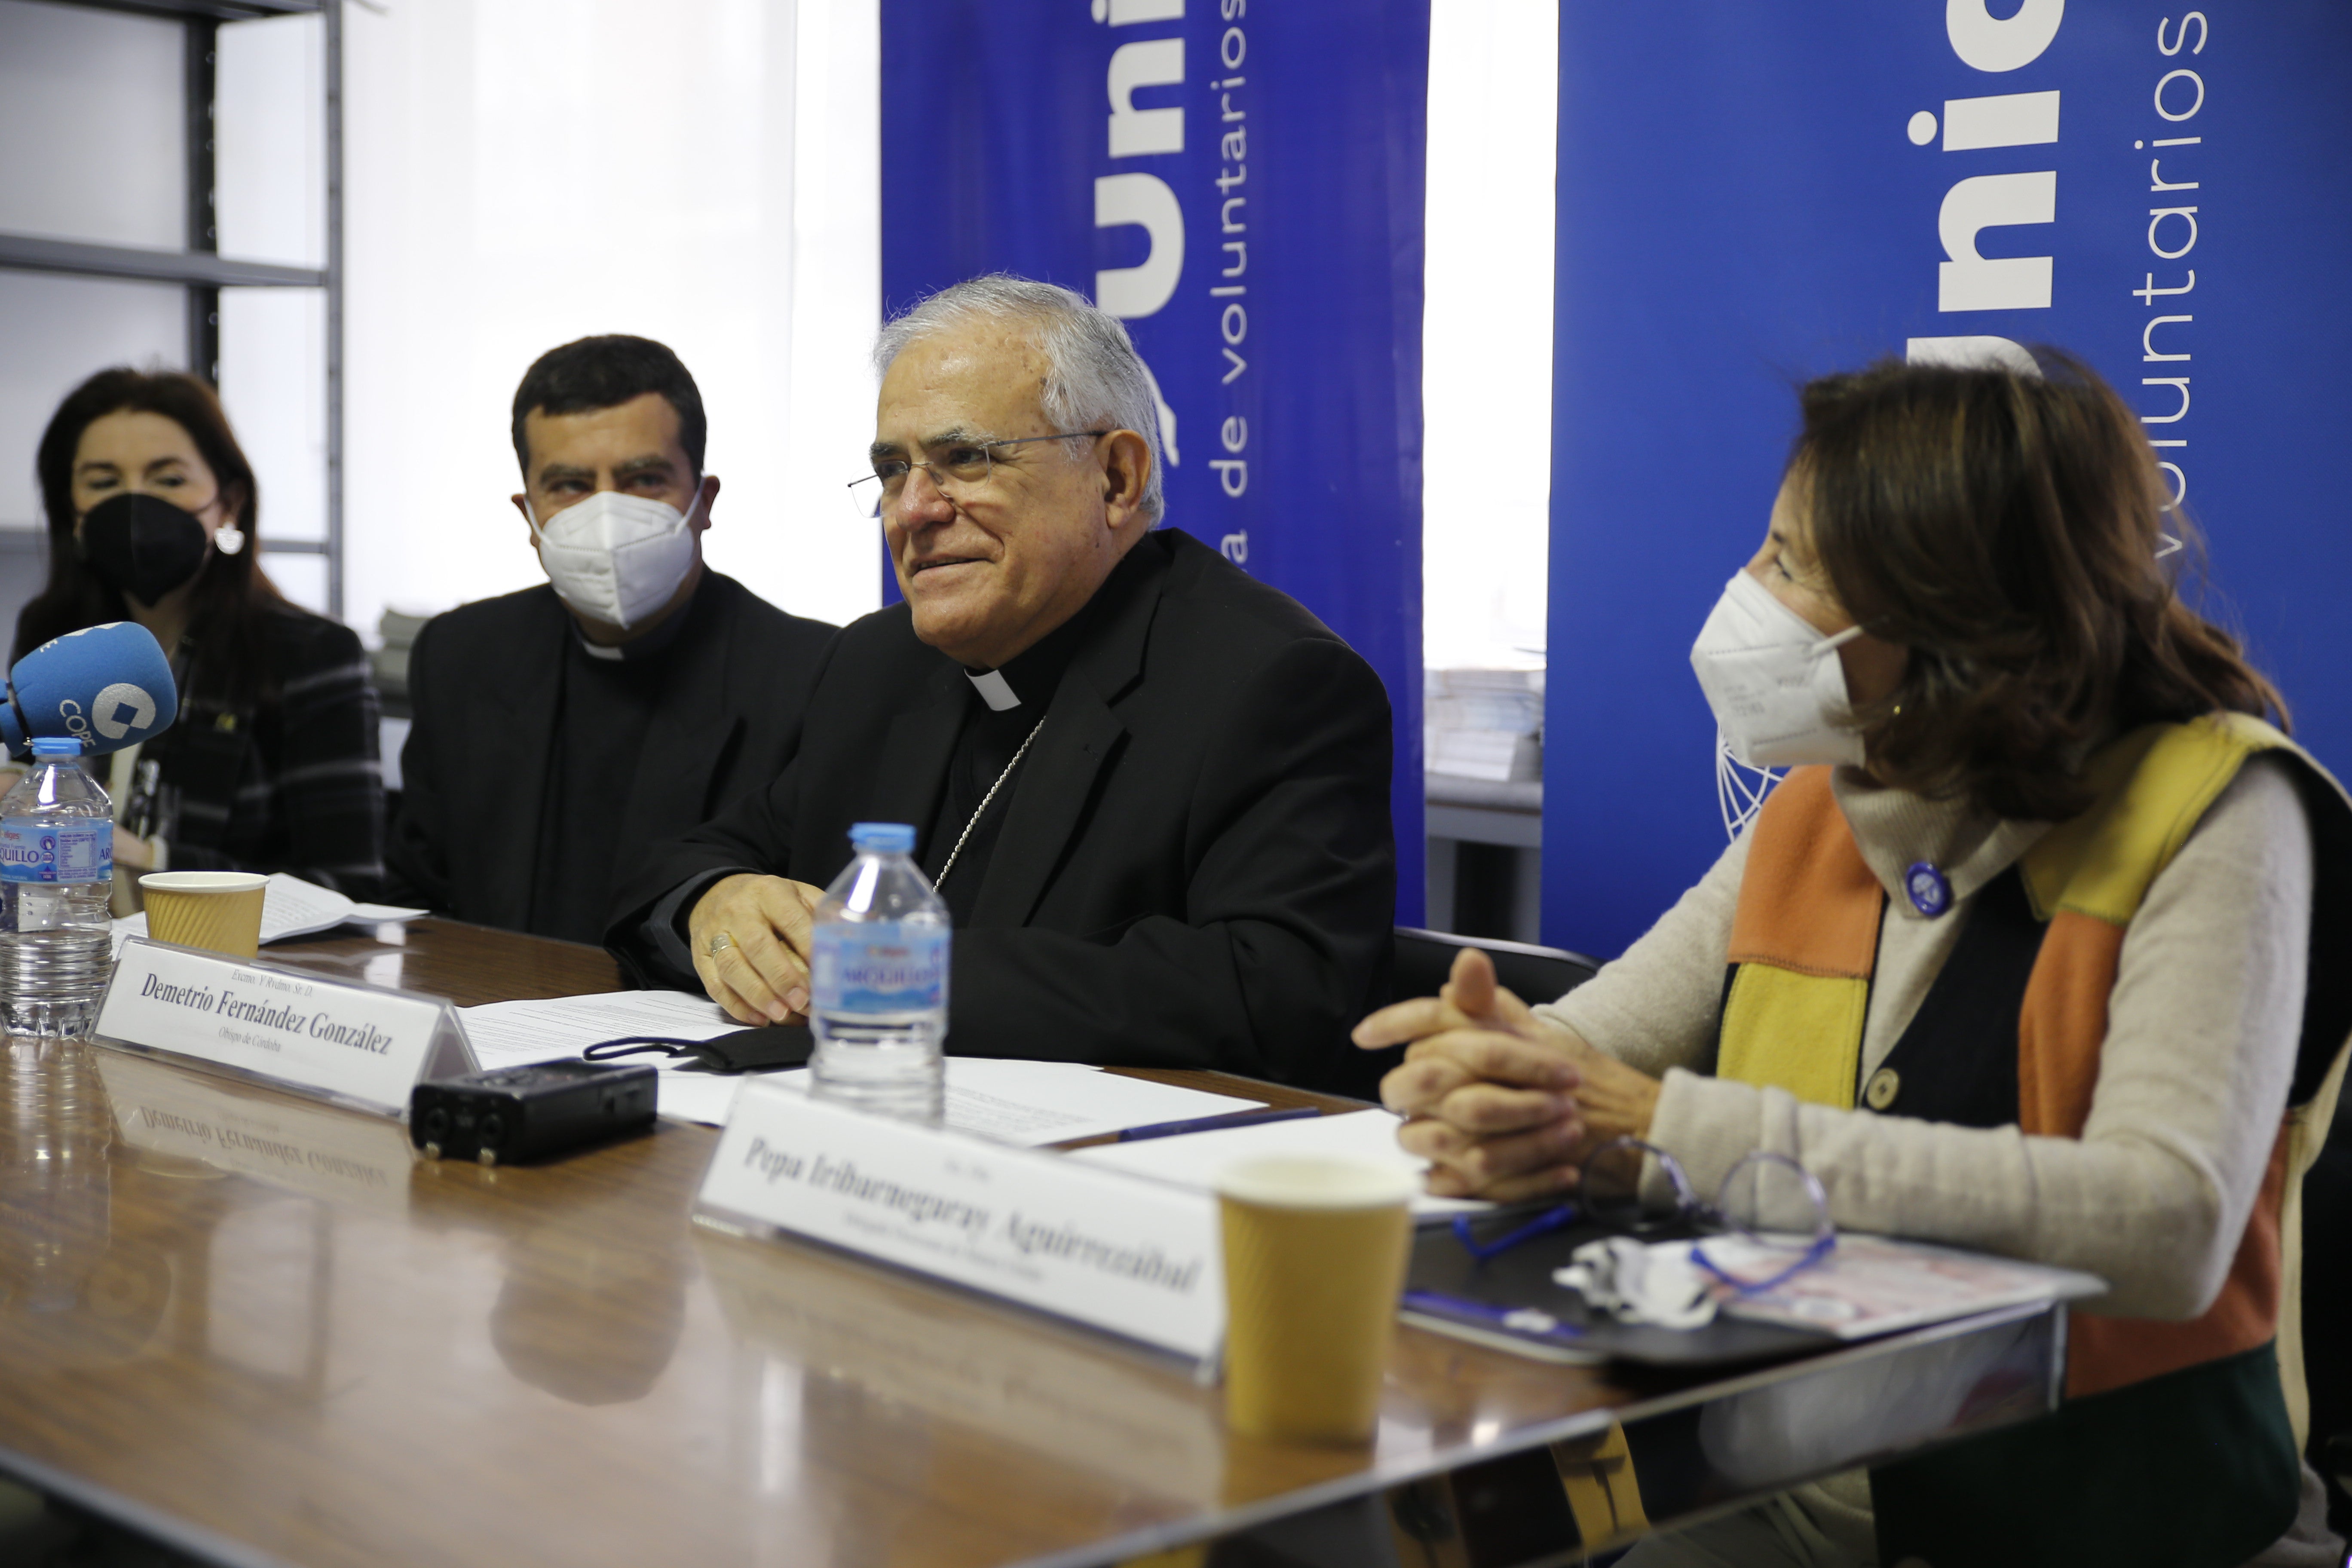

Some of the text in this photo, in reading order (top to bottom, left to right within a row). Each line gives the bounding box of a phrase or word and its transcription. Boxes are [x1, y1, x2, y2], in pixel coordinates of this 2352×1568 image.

[2133, 11, 2208, 559] voluntarios
[1209, 416, 1247, 497] de
[140, 972, 393, 1055] Demetrio Fernández González
